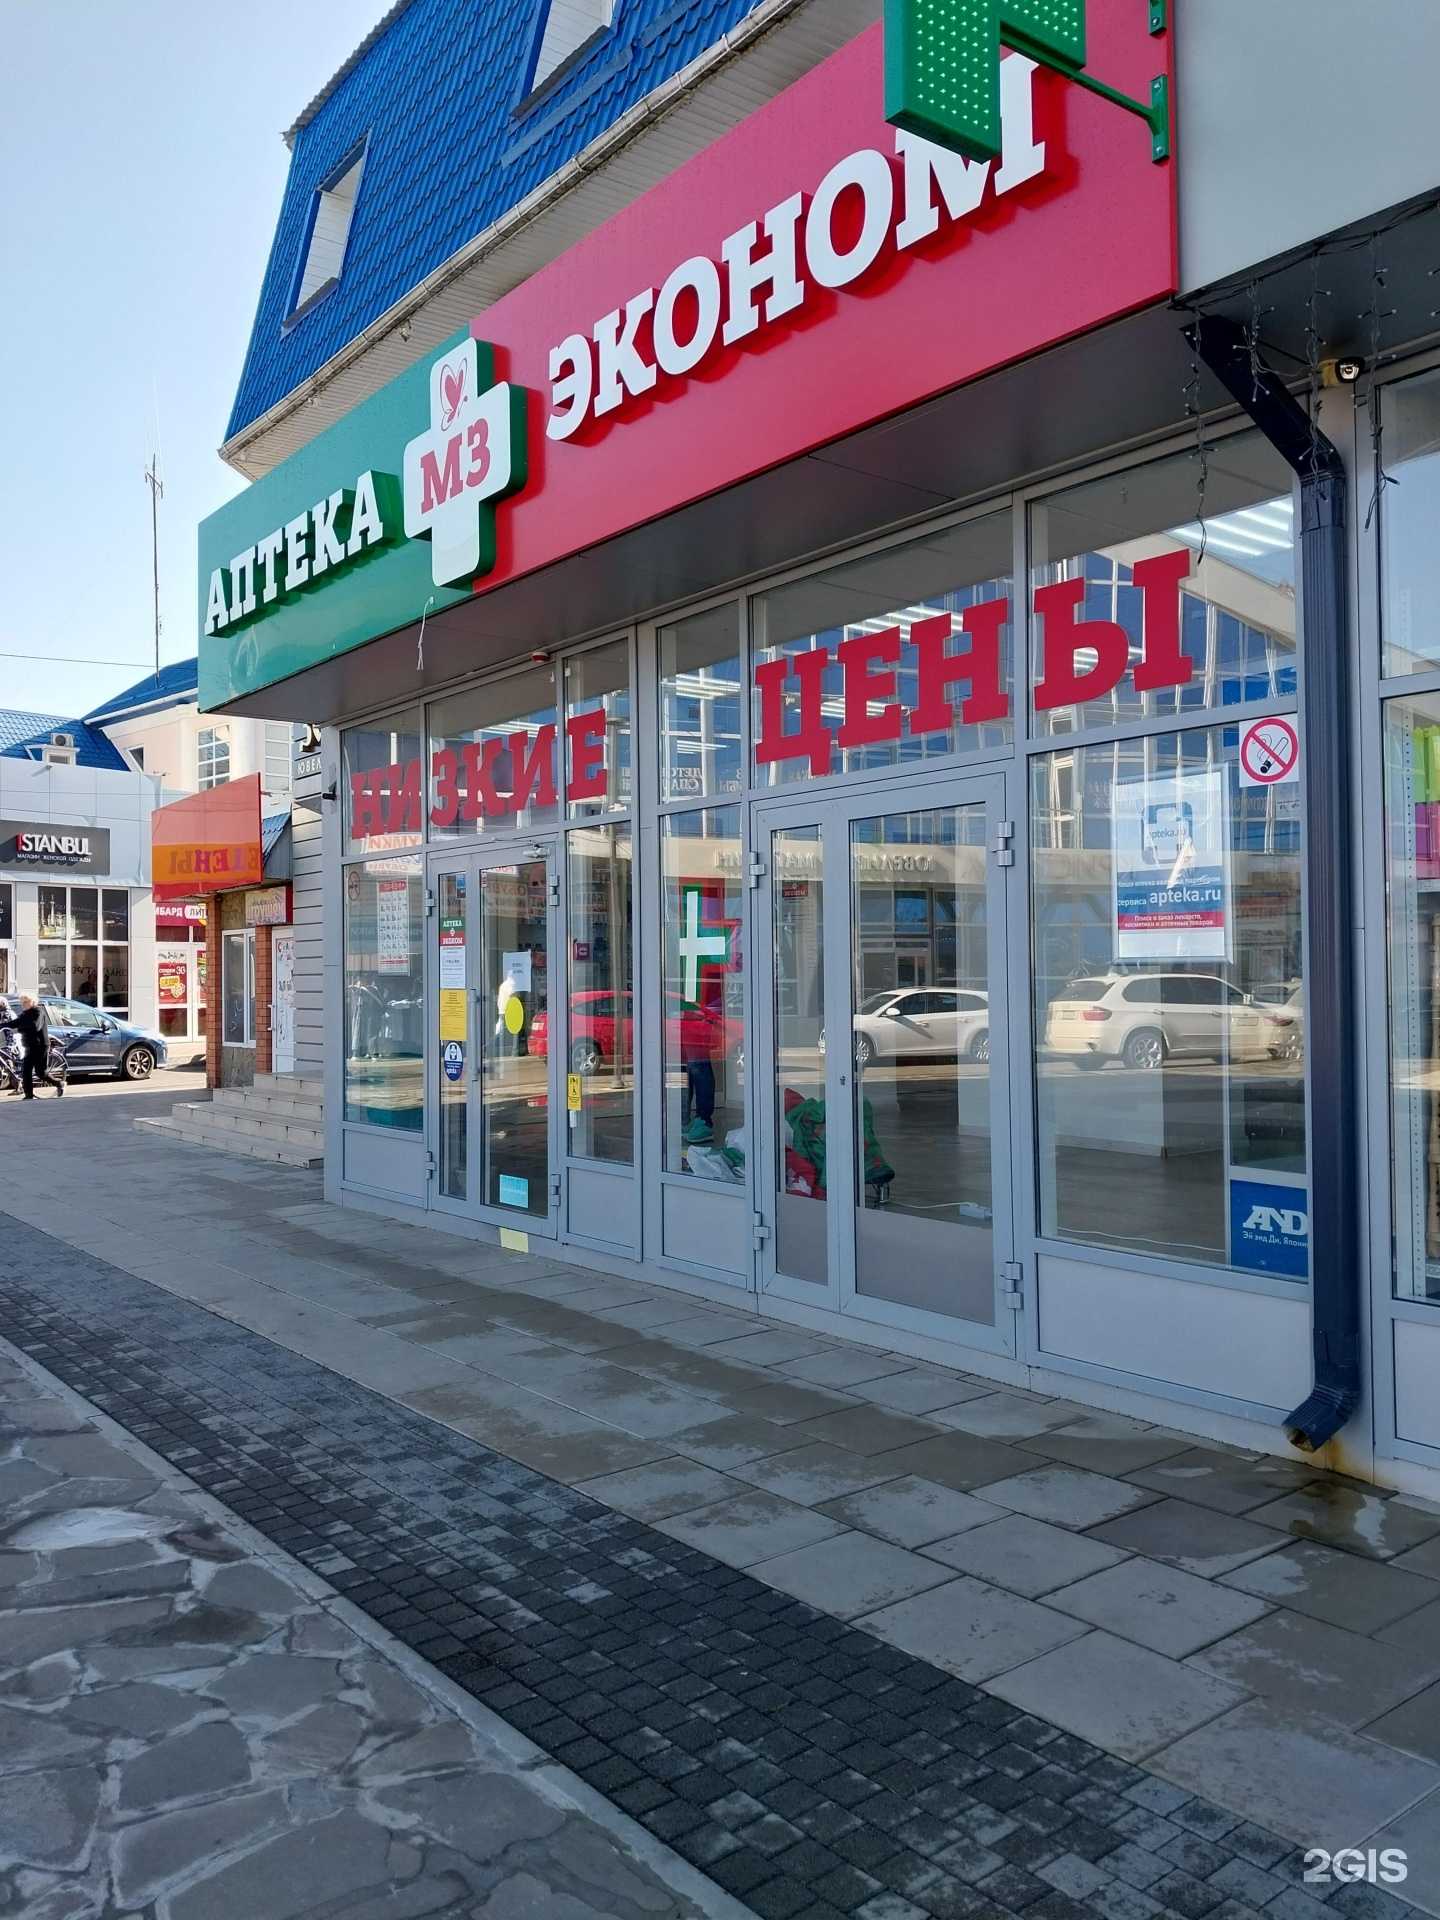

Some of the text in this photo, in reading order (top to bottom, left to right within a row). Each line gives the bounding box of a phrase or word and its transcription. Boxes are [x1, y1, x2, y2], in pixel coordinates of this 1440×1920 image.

[546, 52, 1046, 441] ЭКОНОМ
[420, 418, 491, 514] МЗ
[205, 470, 383, 635] АПТЕКА
[351, 548, 1192, 840] НИЗКИЕ ЦЕНЫ
[1150, 886, 1221, 907] apteka.ru
[1242, 1205, 1308, 1236] AND
